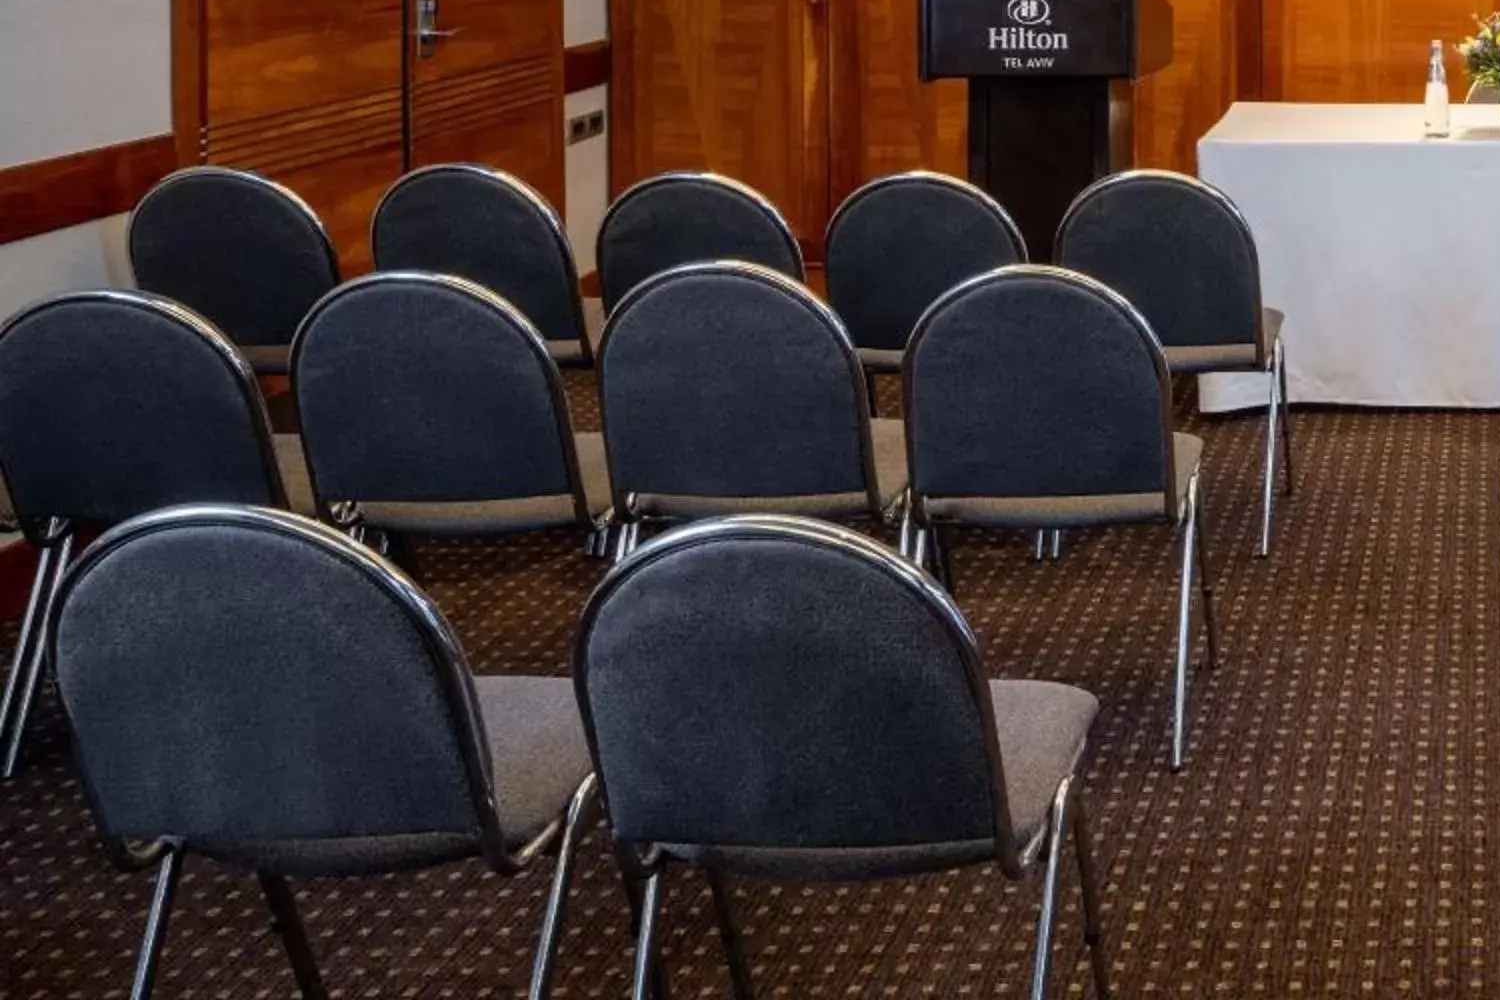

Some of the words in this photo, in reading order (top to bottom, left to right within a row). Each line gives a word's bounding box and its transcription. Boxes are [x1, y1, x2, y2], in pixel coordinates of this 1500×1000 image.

[989, 27, 1068, 49] Hilton
[1004, 57, 1023, 68] TEL
[1027, 57, 1055, 68] AVIV
